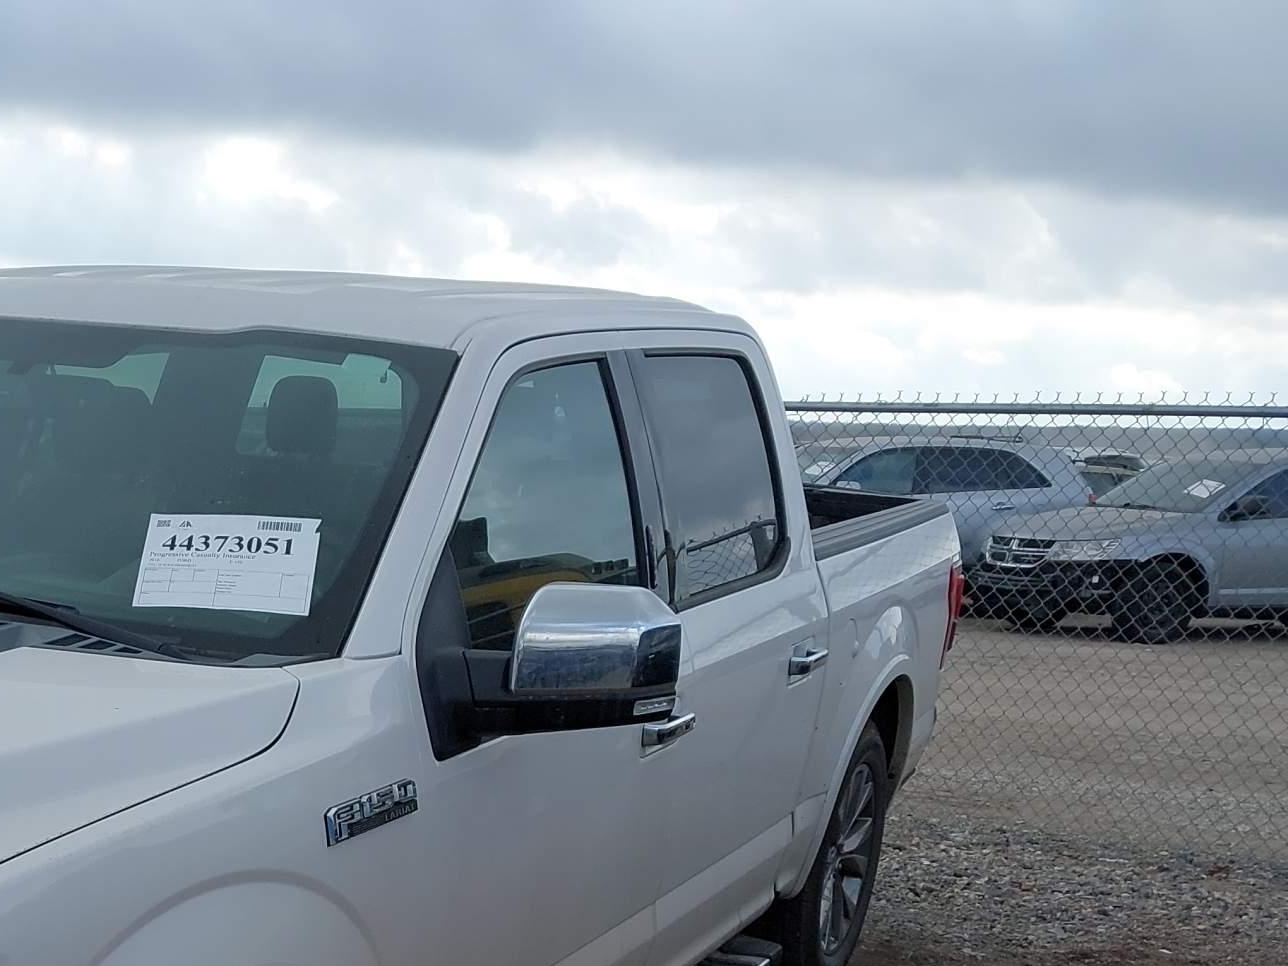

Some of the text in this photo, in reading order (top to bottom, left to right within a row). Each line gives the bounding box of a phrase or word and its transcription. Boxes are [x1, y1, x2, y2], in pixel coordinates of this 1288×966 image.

[162, 534, 295, 556] 44373051
[191, 552, 221, 560] Casualty
[223, 552, 256, 560] Insurance
